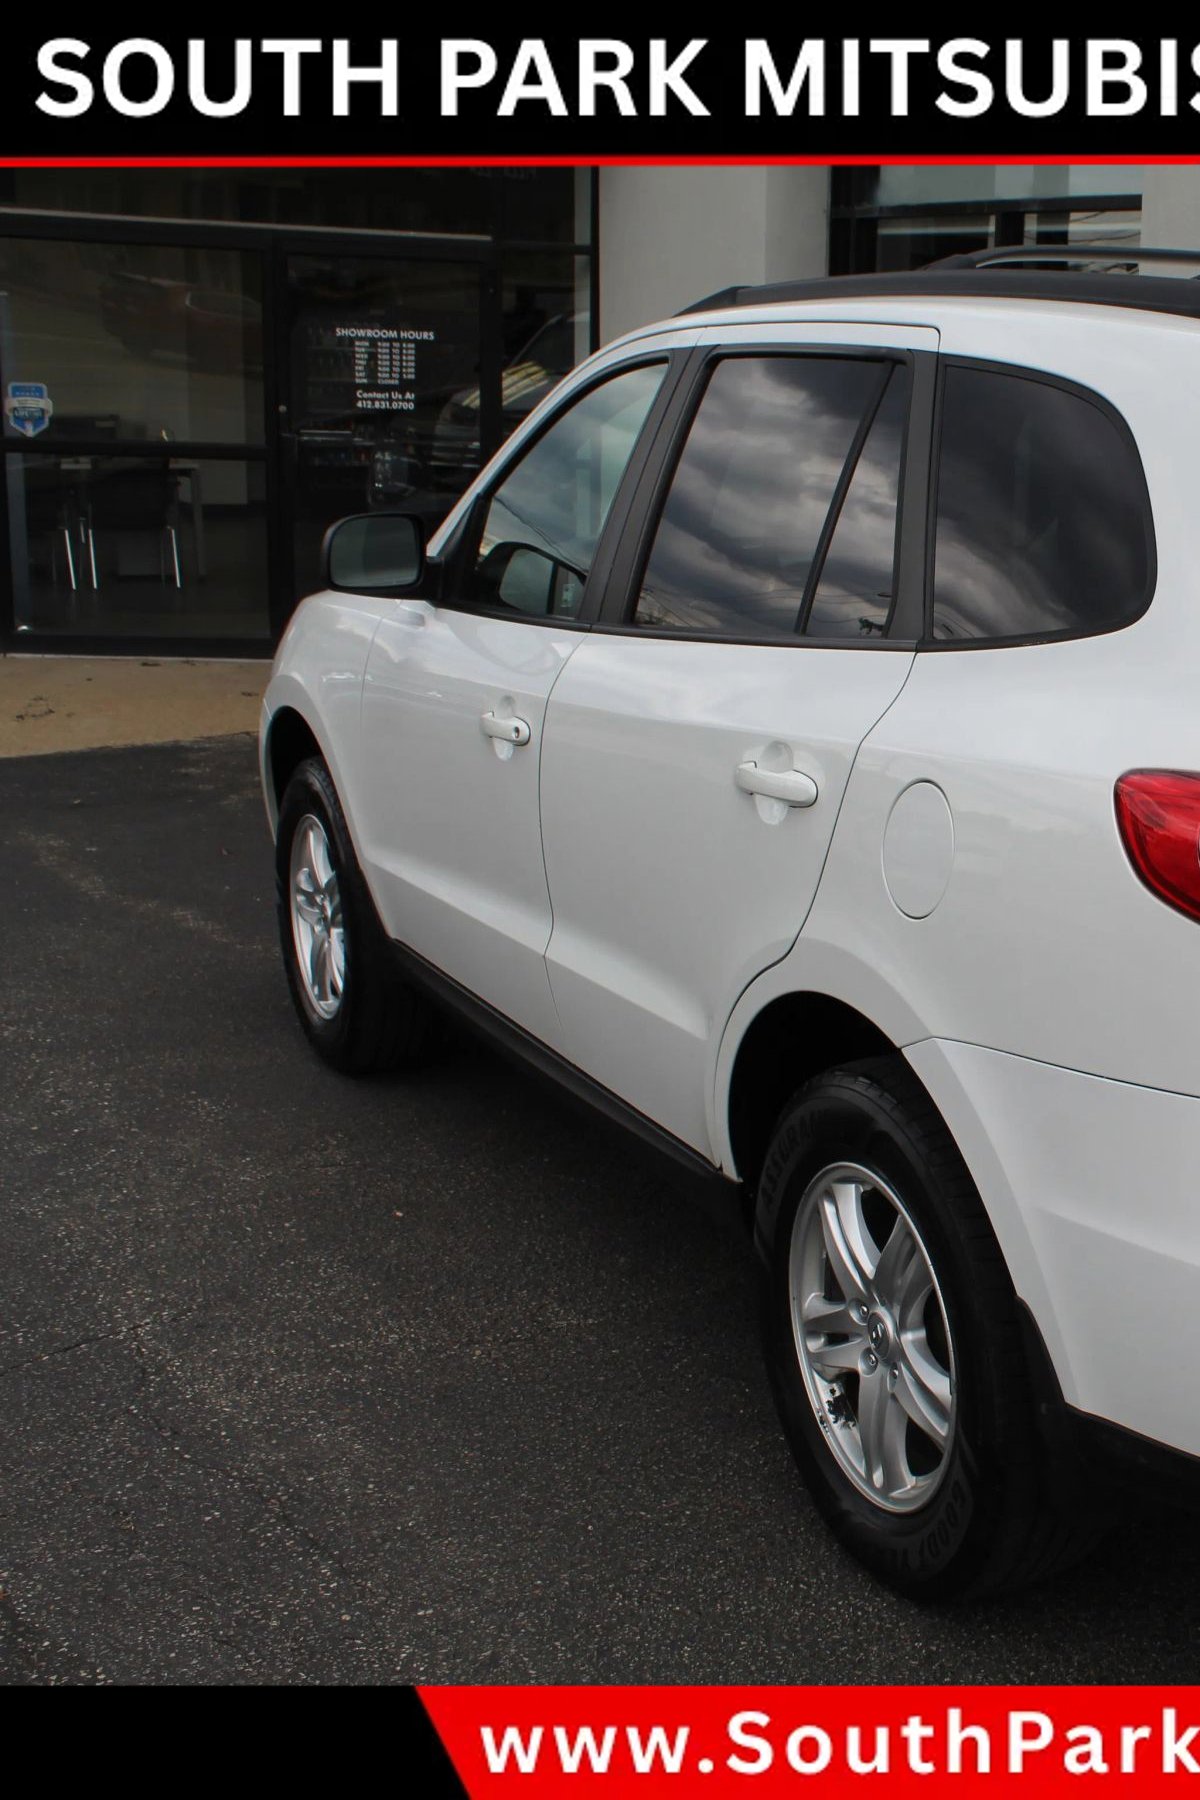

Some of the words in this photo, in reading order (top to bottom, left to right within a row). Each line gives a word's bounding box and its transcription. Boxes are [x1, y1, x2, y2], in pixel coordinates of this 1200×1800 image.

[337, 328, 398, 338] SHOWROOM
[401, 330, 435, 340] HOURS
[357, 390, 389, 399] Contact
[392, 391, 402, 399] Us
[357, 400, 414, 410] 412.831.0700
